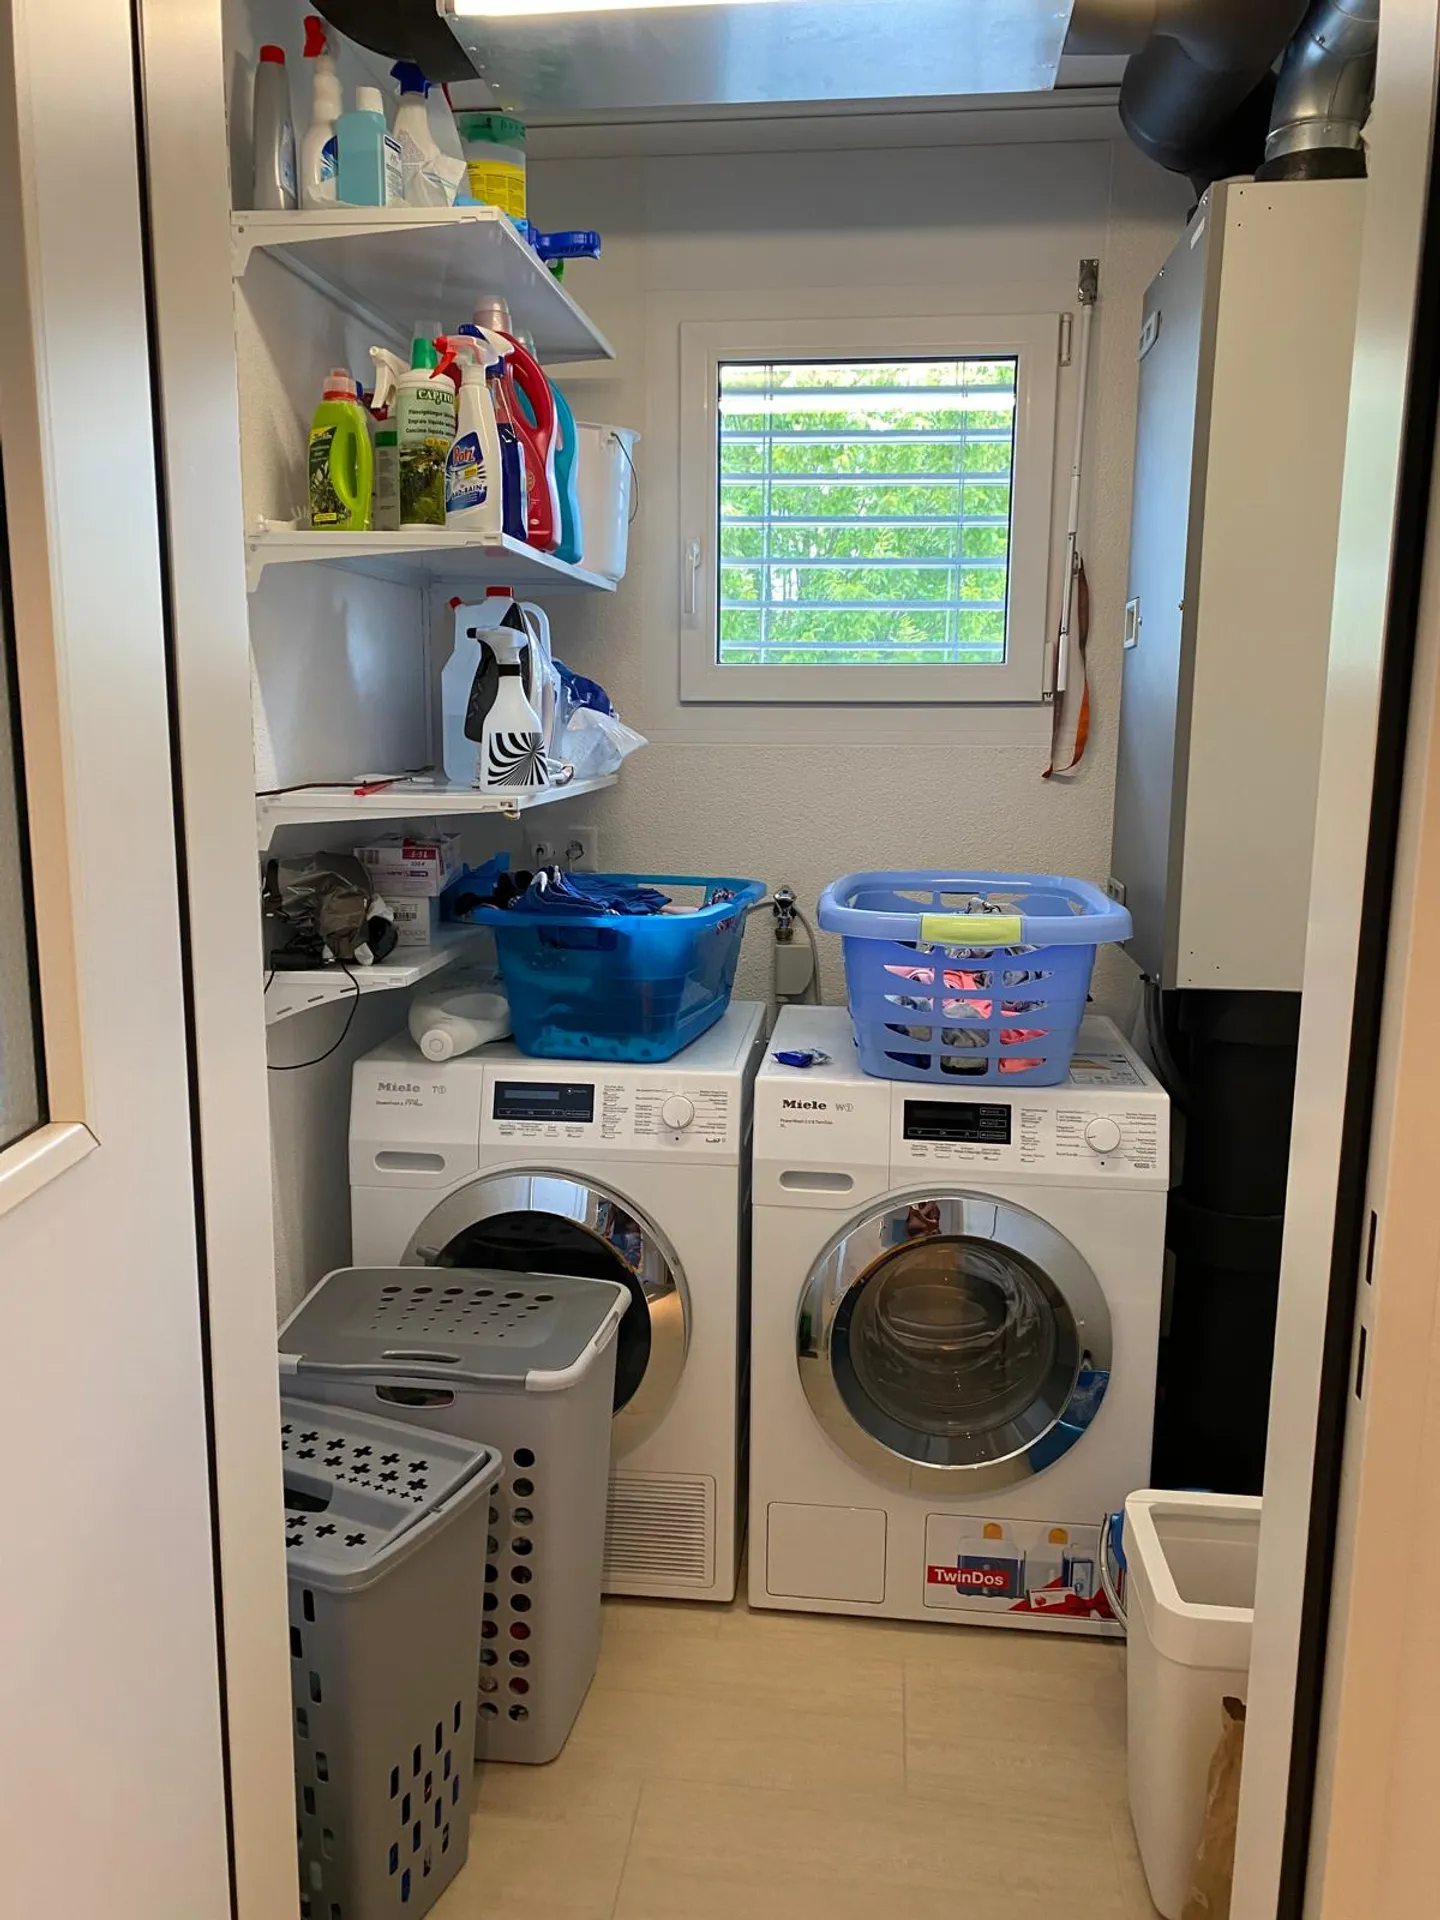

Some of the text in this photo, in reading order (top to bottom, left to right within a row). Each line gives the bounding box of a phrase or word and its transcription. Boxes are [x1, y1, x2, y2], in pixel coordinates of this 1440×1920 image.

[377, 1082, 421, 1092] Miele
[783, 1099, 827, 1110] Miele
[934, 1568, 1004, 1586] TwinDos
